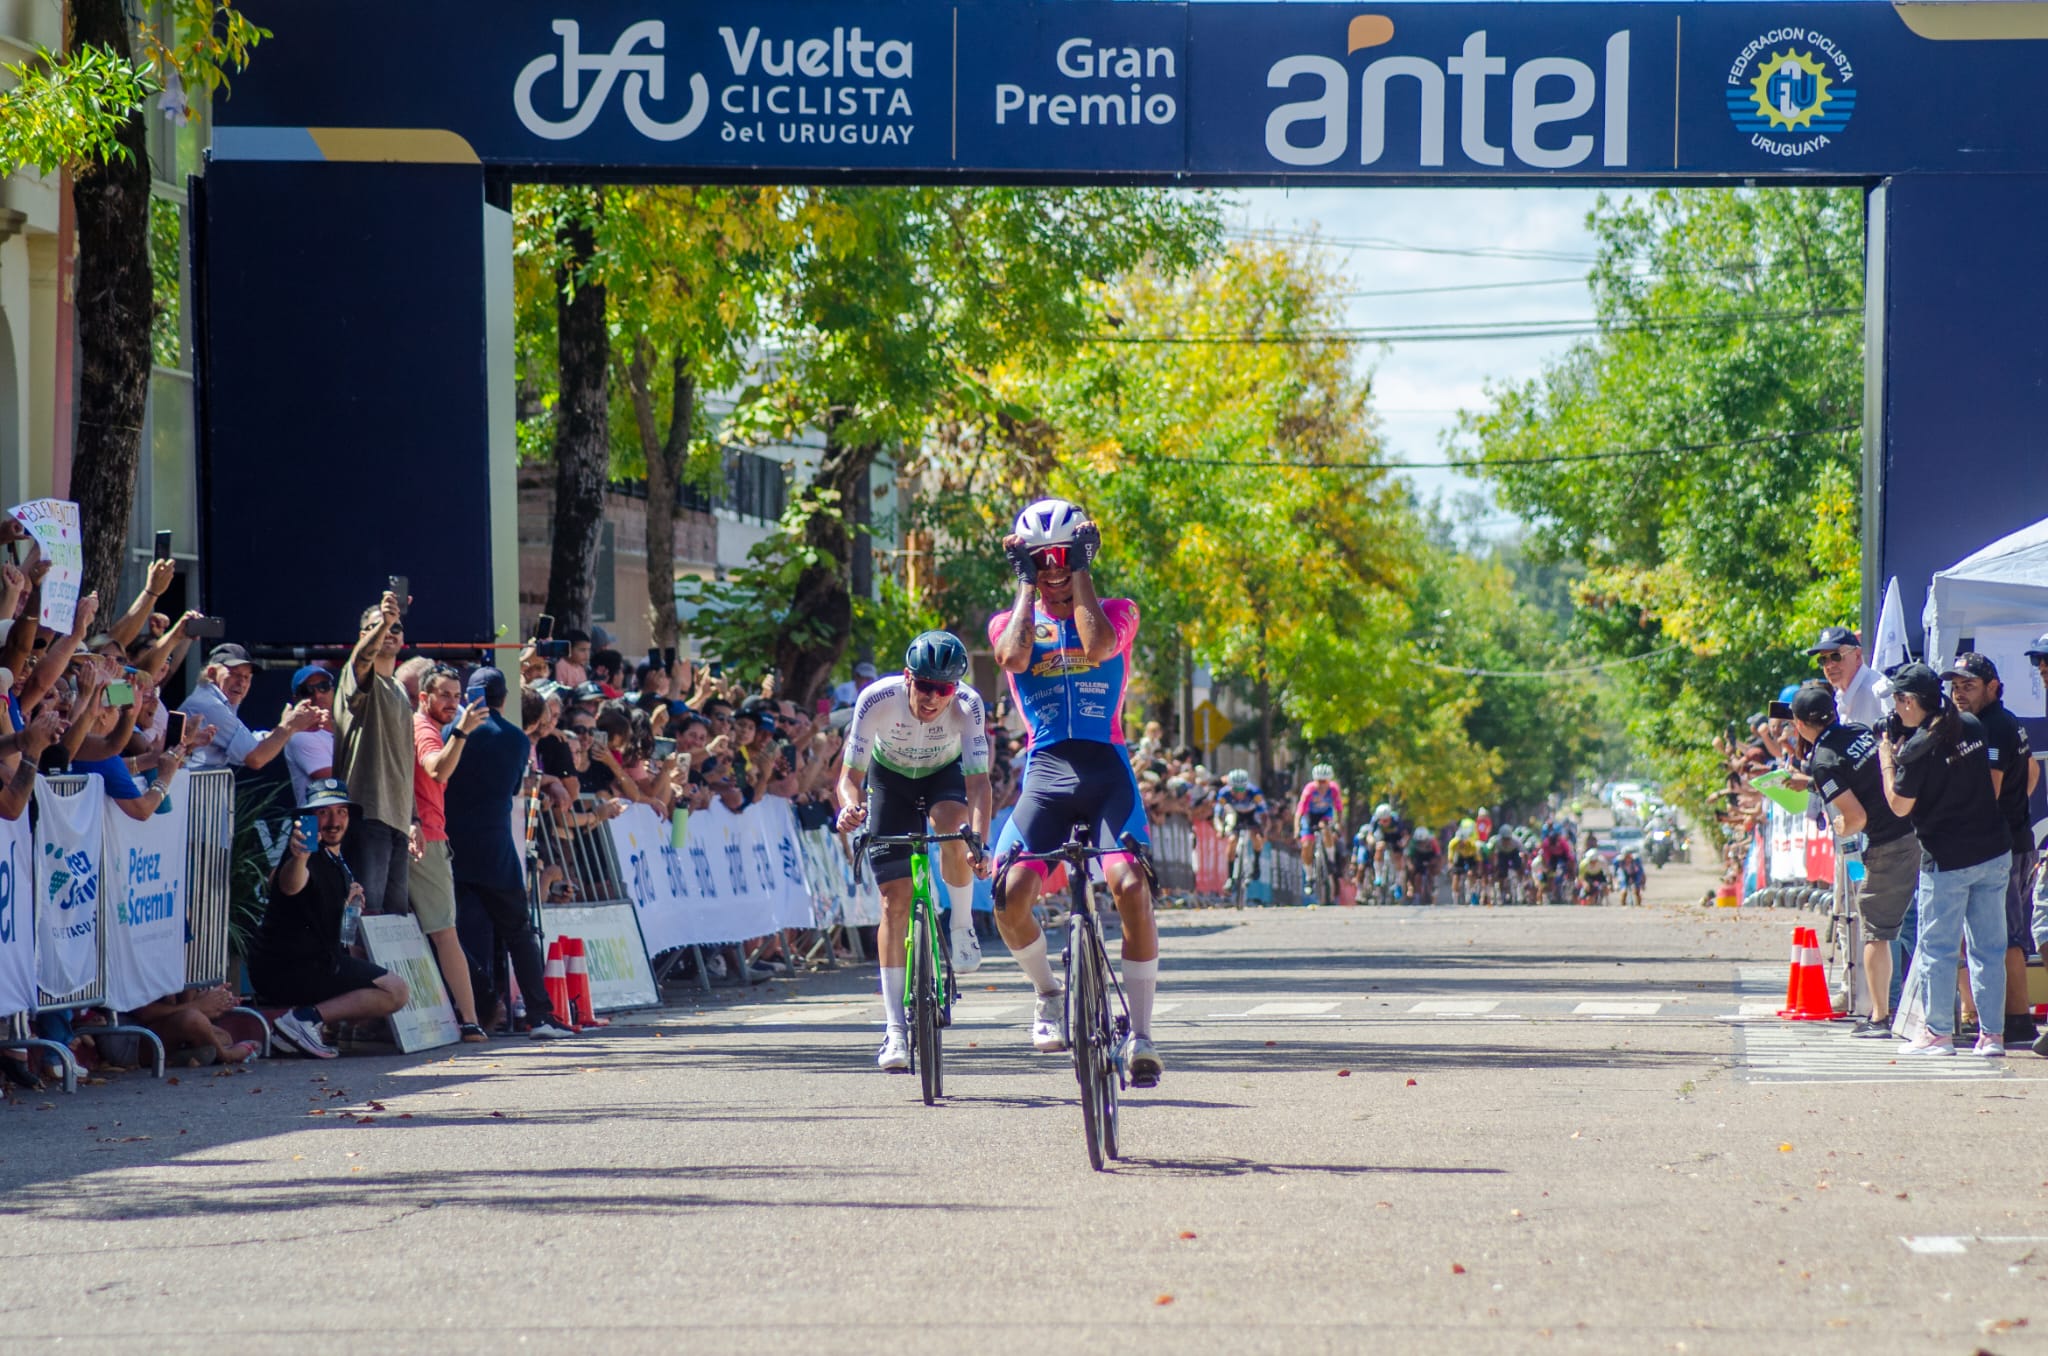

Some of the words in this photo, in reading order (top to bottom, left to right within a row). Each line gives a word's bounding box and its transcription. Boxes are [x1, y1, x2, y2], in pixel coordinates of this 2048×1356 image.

[718, 26, 913, 79] Vuelta
[1056, 37, 1176, 79] Gran
[1727, 26, 1804, 86] FEDERACION
[1807, 30, 1854, 83] CICLISTA
[721, 85, 913, 116] CICLISTA
[995, 83, 1177, 125] Premio
[1265, 28, 1630, 168] antel
[720, 121, 766, 142] del
[779, 122, 914, 144] URUGUAY
[1751, 132, 1831, 156] URUGUAYA
[858, 688, 896, 721] SHIMANO
[128, 847, 160, 885] Pérez
